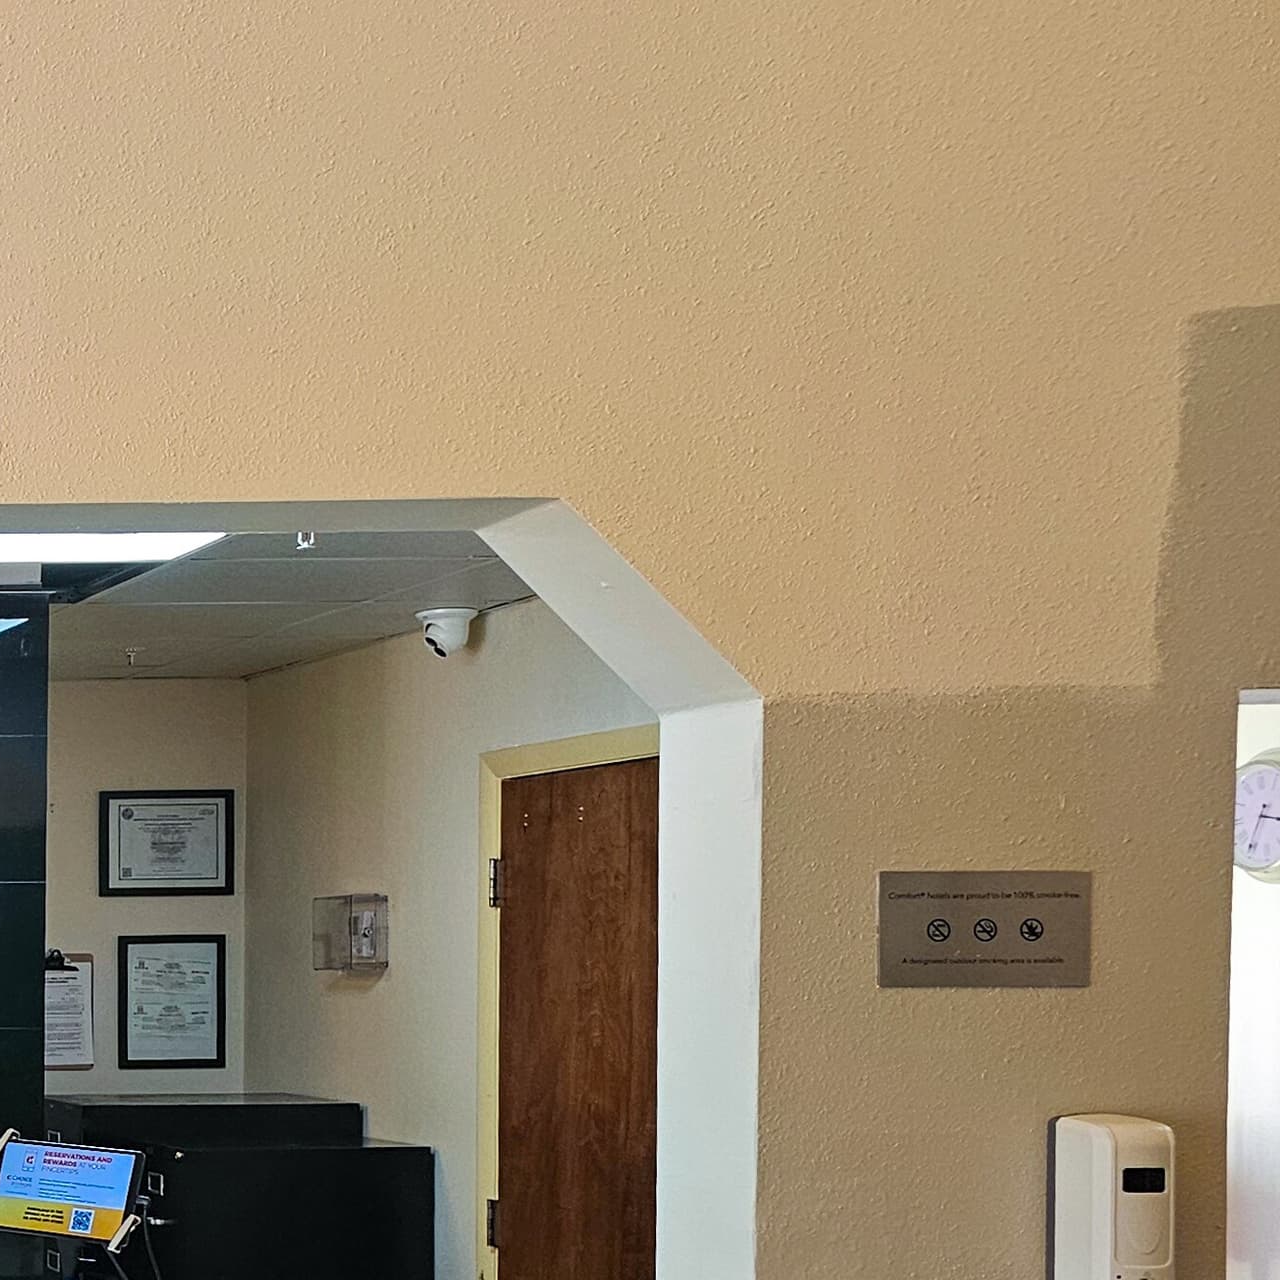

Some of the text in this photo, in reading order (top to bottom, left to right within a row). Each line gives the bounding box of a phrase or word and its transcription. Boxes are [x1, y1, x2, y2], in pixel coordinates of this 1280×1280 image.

[43, 1158, 77, 1167] REWARDS
[44, 1151, 113, 1164] RESERVATIONS AND
